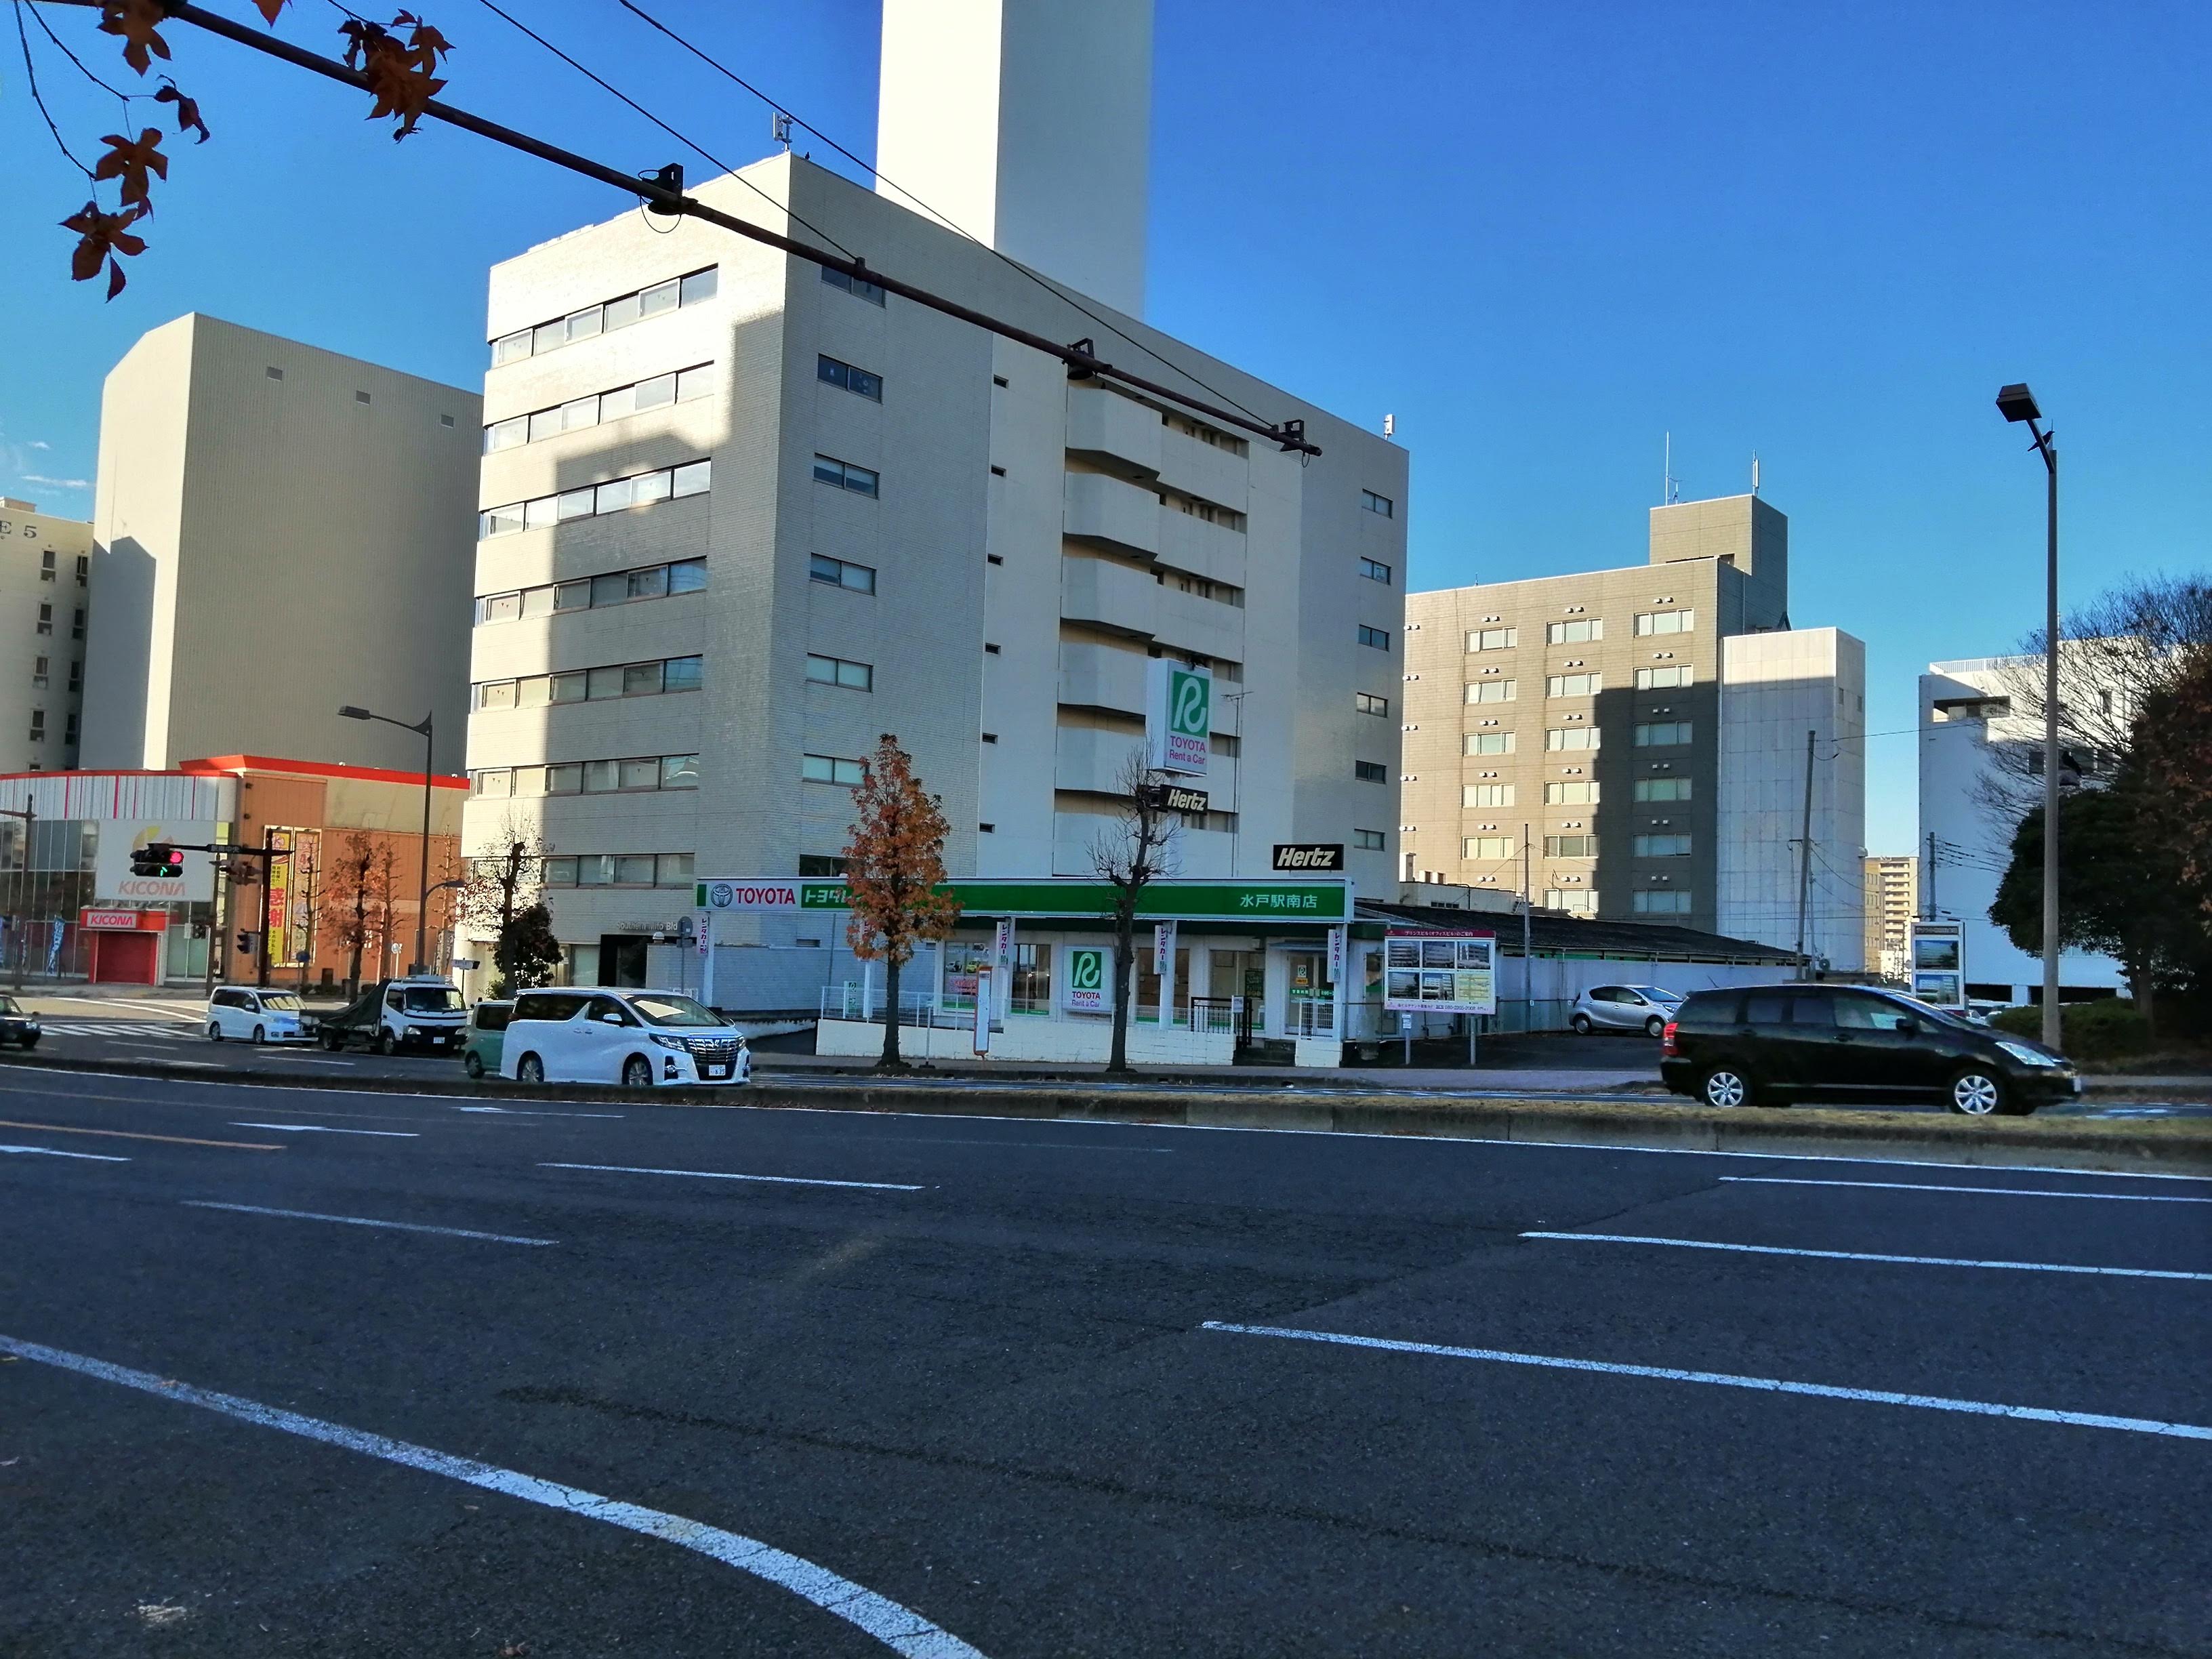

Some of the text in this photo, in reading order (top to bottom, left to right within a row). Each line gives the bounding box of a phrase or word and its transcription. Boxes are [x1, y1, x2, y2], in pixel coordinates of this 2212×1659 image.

[24, 525, 37, 538] 5
[1170, 735, 1206, 753] TOYOTA
[1169, 749, 1186, 762] Rent
[1193, 754, 1205, 764] Car
[1168, 789, 1206, 811] Hertz
[1277, 847, 1336, 866] Hertz
[119, 881, 185, 896] KICONA
[736, 888, 796, 904] TOYOTA
[1240, 894, 1317, 908] 水戸駅南店
[91, 916, 133, 925] KICONA
[1071, 991, 1101, 1000] TOYOTA
